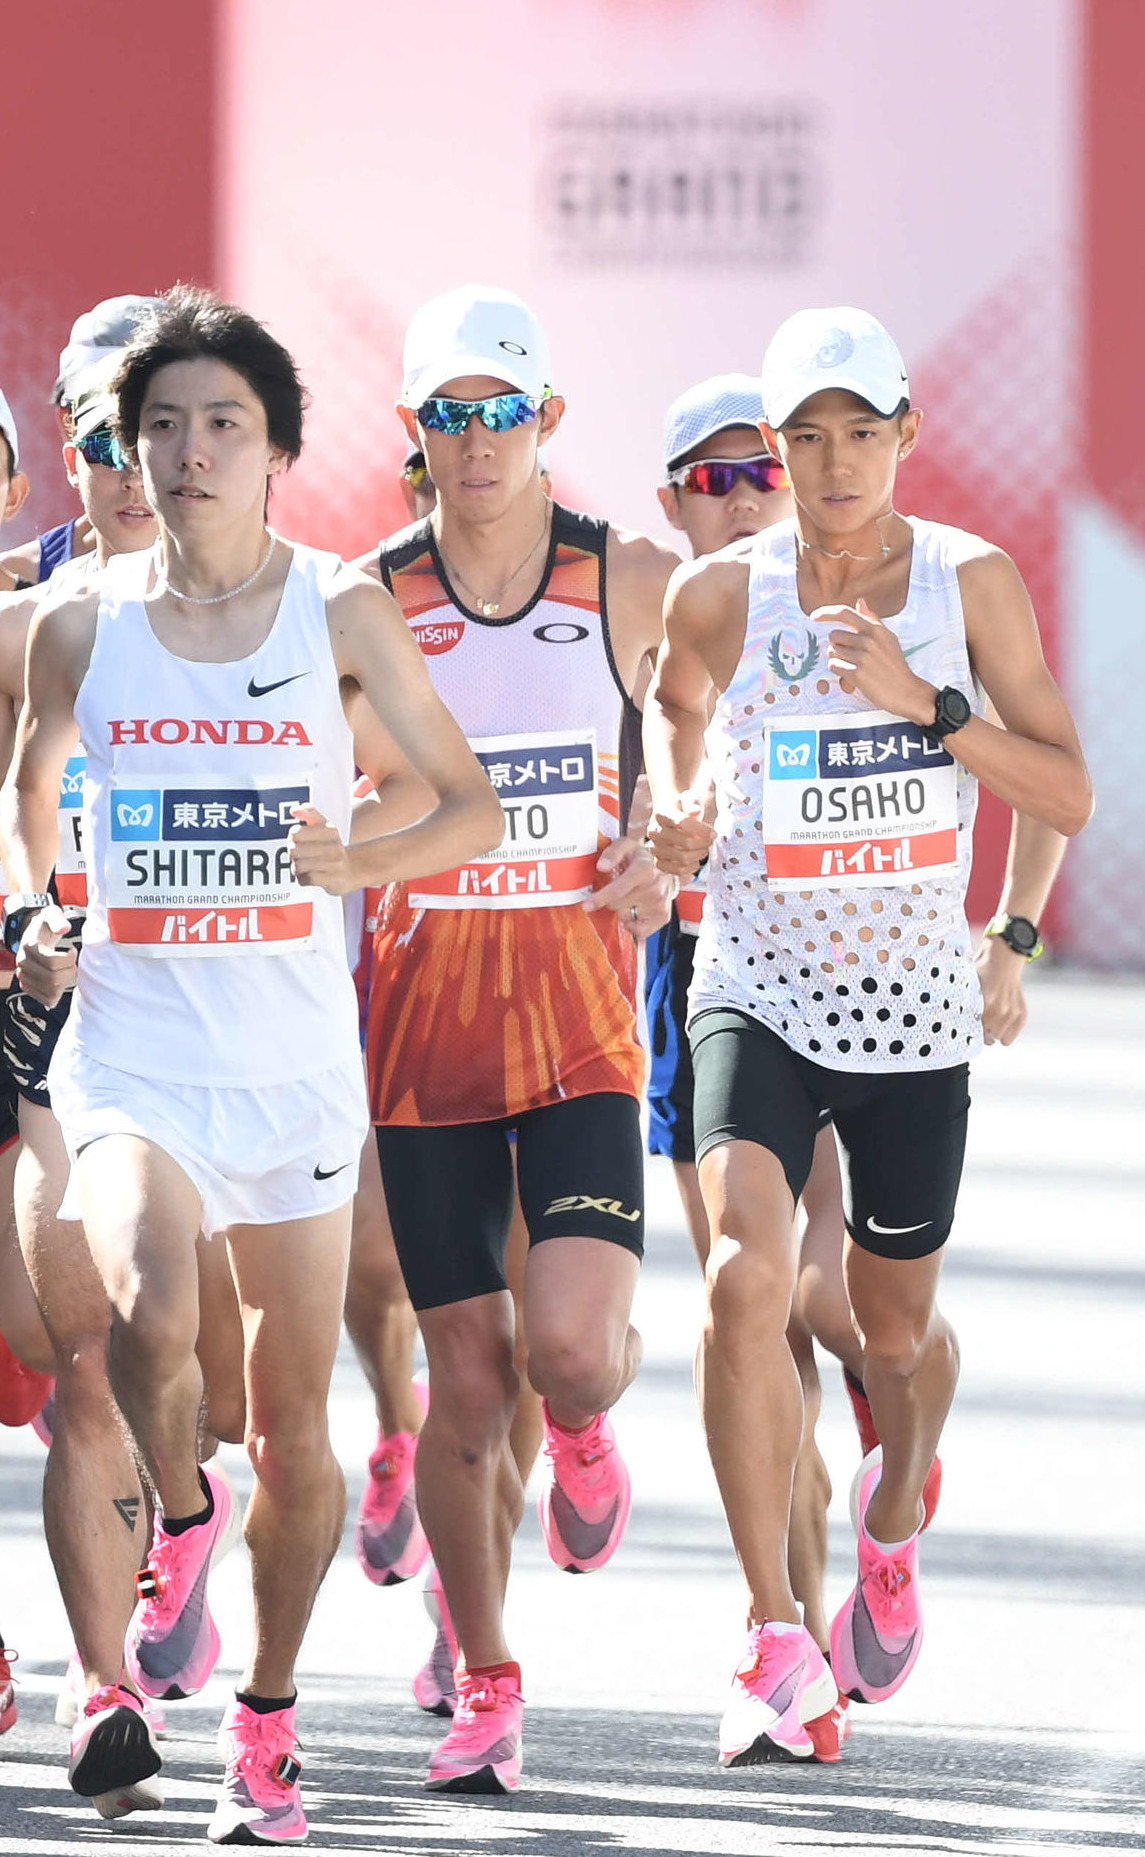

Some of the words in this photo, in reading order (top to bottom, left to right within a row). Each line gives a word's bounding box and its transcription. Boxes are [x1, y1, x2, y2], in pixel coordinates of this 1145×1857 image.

[107, 718, 313, 746] HONDA
[827, 735, 944, 766] 東京メトロ
[484, 756, 584, 788] 京メトロ
[172, 800, 301, 828] 東京メトロ
[801, 778, 925, 823] OSAKO
[503, 804, 549, 840] TO
[790, 830, 841, 841] MARATHON
[843, 828, 873, 839] GRAND
[875, 819, 938, 836] CHAMPIONSHIP
[126, 847, 296, 886] SHITARA
[511, 844, 578, 858] CHAMPIONSHIP
[820, 838, 914, 875] バイトル
[457, 861, 552, 895] バイトル
[134, 894, 185, 904] MARATHON
[187, 894, 219, 904] GRAND
[221, 892, 291, 904] CHAMPIONSHIP
[161, 908, 263, 942] バイトル
[543, 1195, 641, 1222] 2XU
